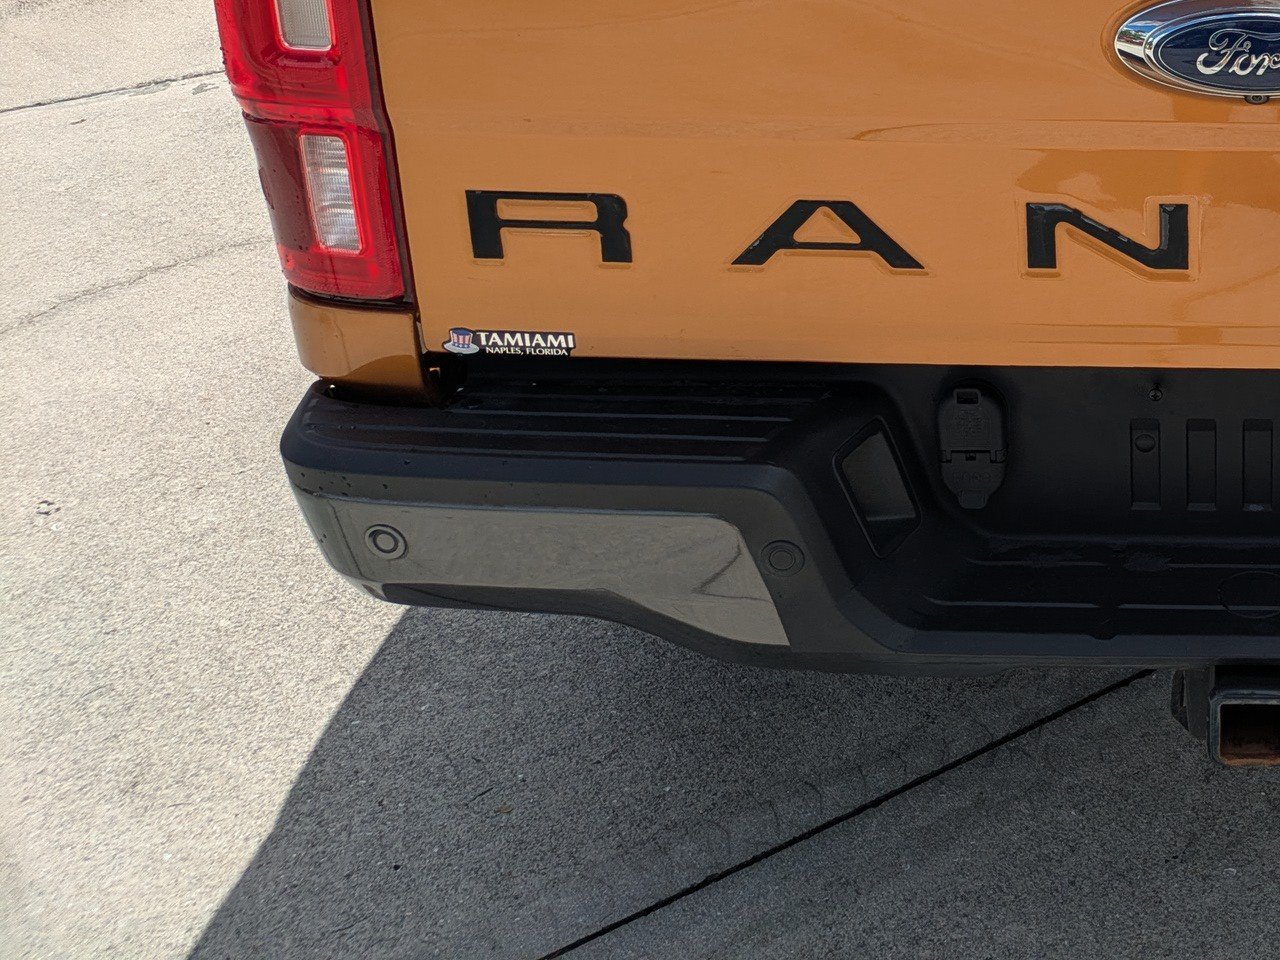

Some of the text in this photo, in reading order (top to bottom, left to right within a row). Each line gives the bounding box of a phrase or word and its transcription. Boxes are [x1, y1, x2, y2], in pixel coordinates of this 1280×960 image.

[477, 332, 574, 348] TAMIAMI
[485, 346, 568, 356] NAPLES, FLORIDA
